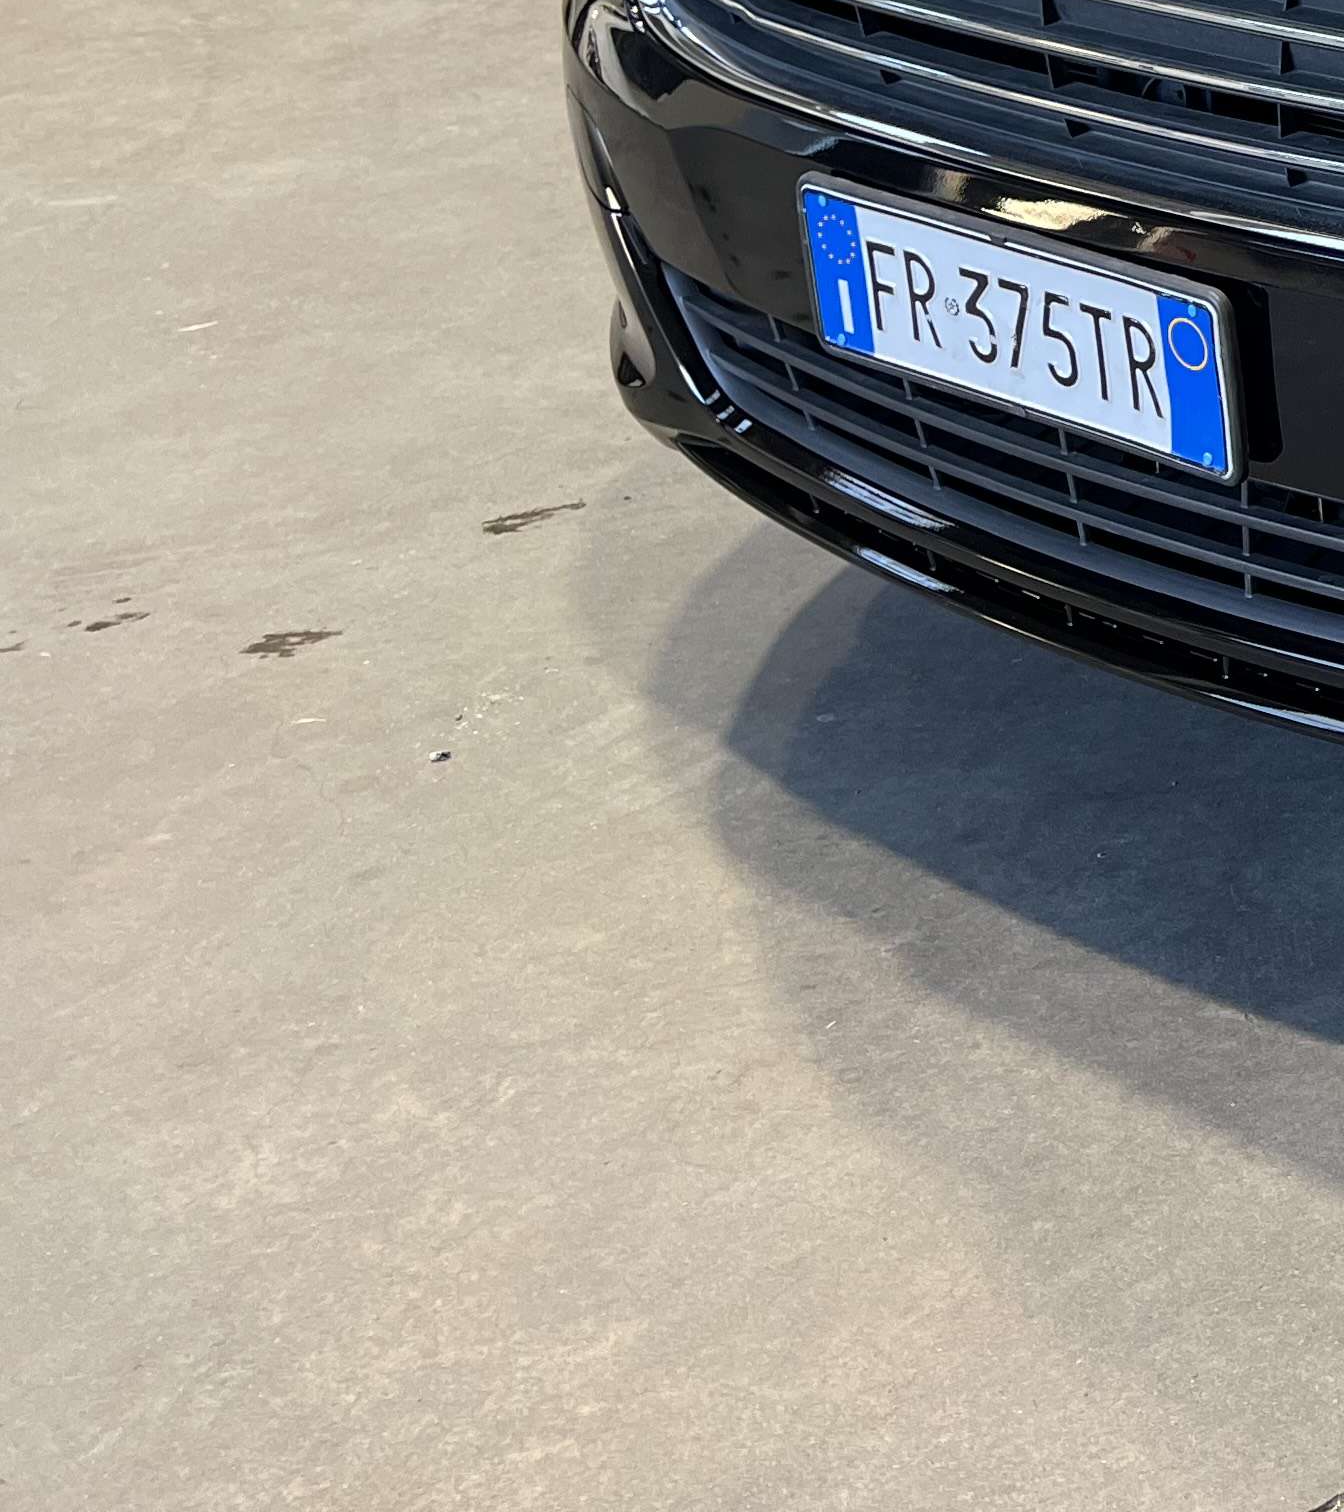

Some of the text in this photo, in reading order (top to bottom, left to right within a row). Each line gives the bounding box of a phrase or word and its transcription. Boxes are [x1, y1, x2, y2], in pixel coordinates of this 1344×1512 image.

[837, 278, 855, 335] I
[865, 240, 1164, 418] FR 375TR
